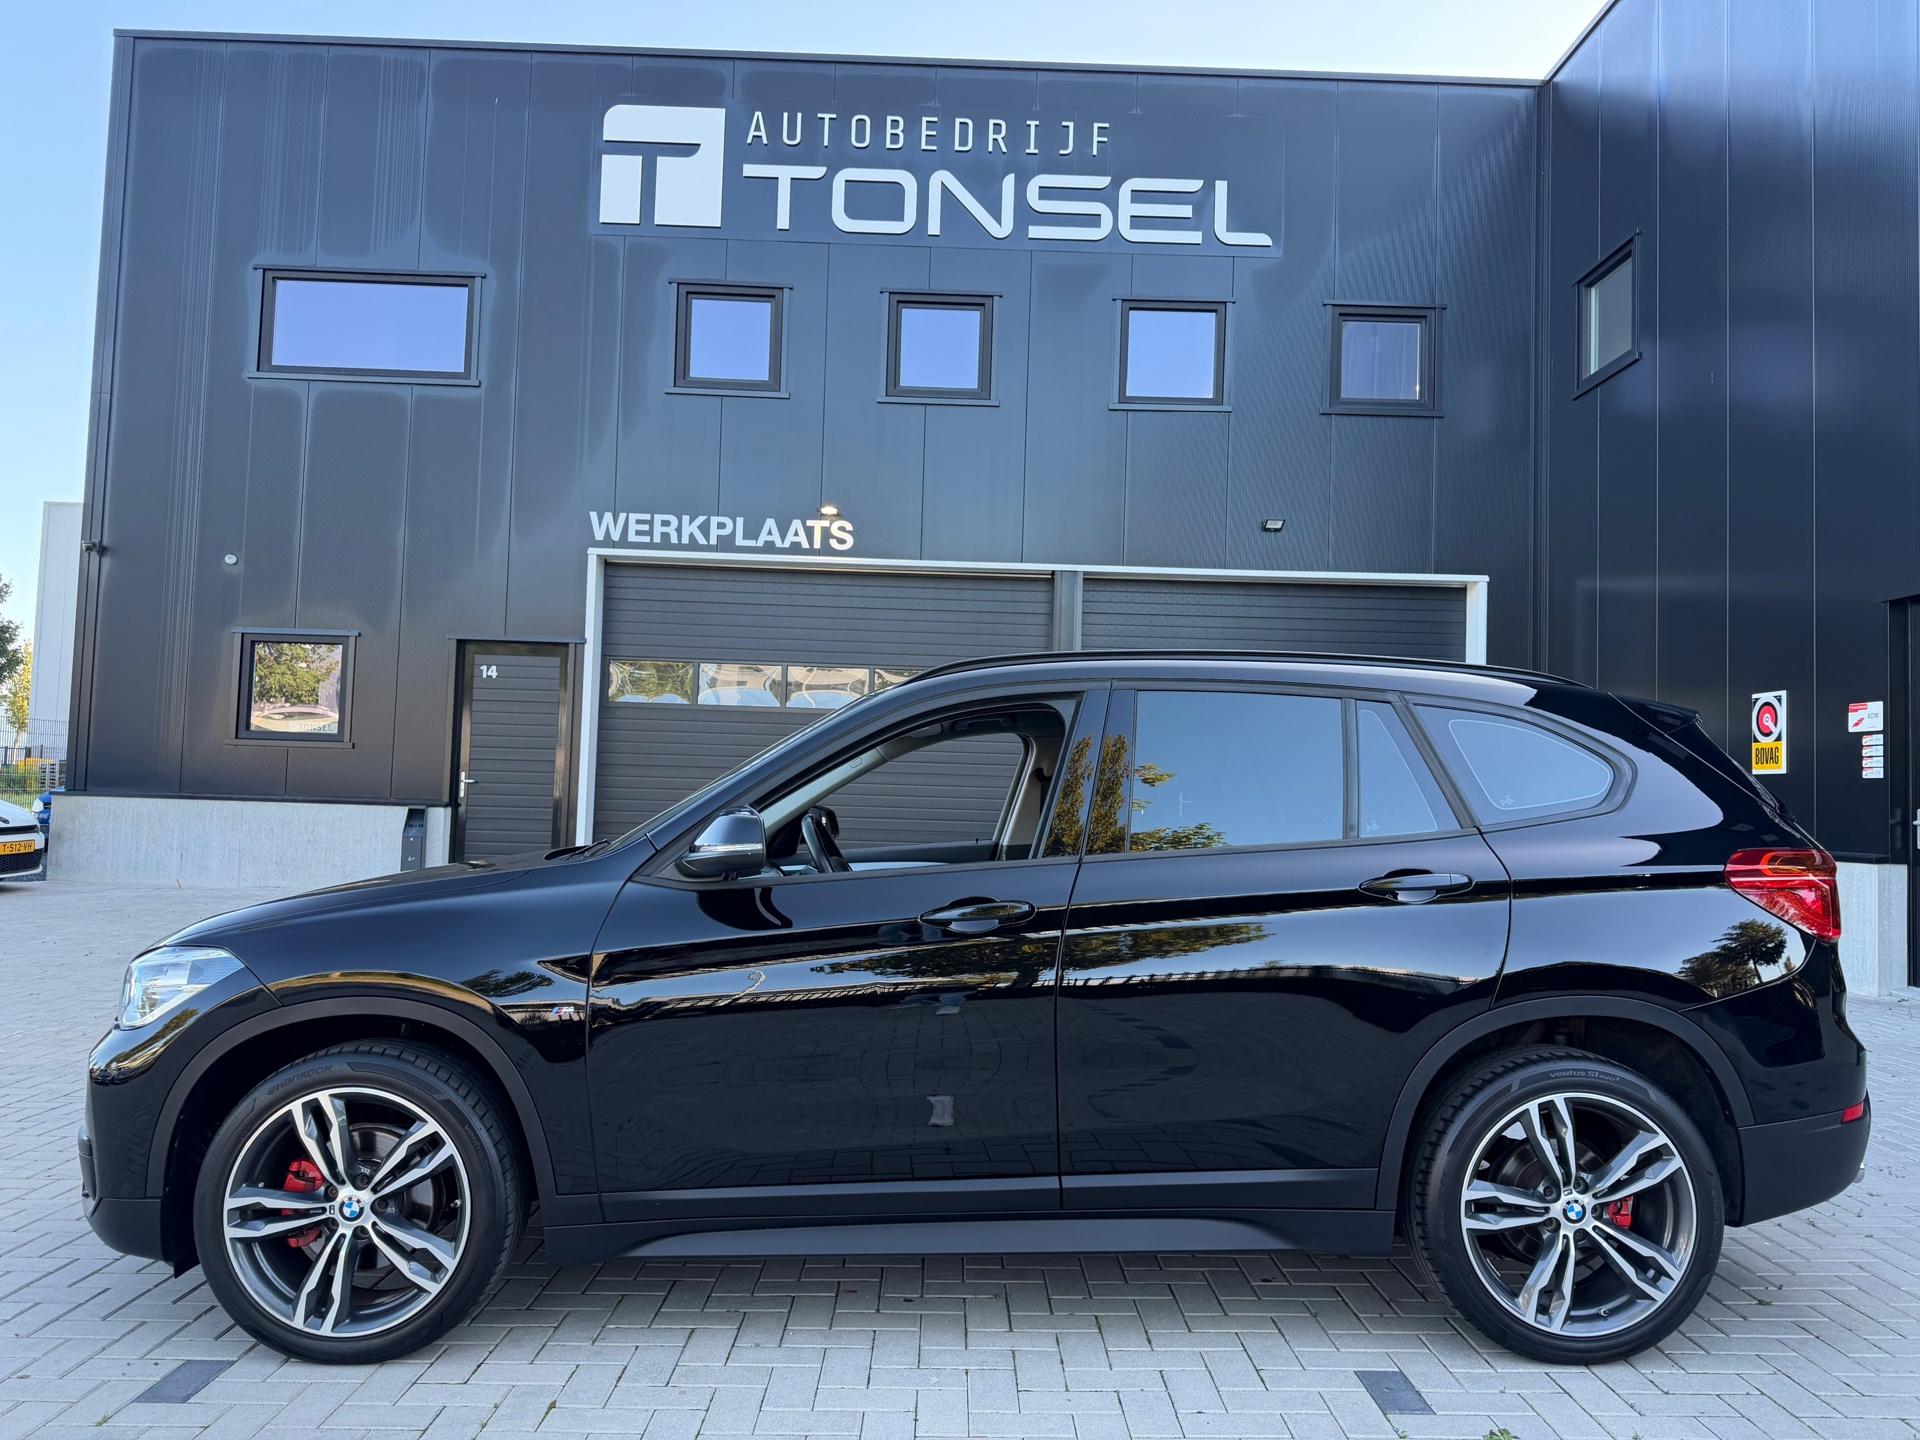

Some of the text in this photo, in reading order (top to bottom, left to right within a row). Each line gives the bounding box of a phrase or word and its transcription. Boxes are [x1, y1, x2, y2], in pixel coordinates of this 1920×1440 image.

[746, 111, 1110, 156] AUTOBEDRIJF
[742, 163, 1272, 247] TONSEL
[589, 511, 854, 551] WERKPLAATS
[480, 665, 497, 678] 14
[1755, 746, 1780, 765] BOVAG
